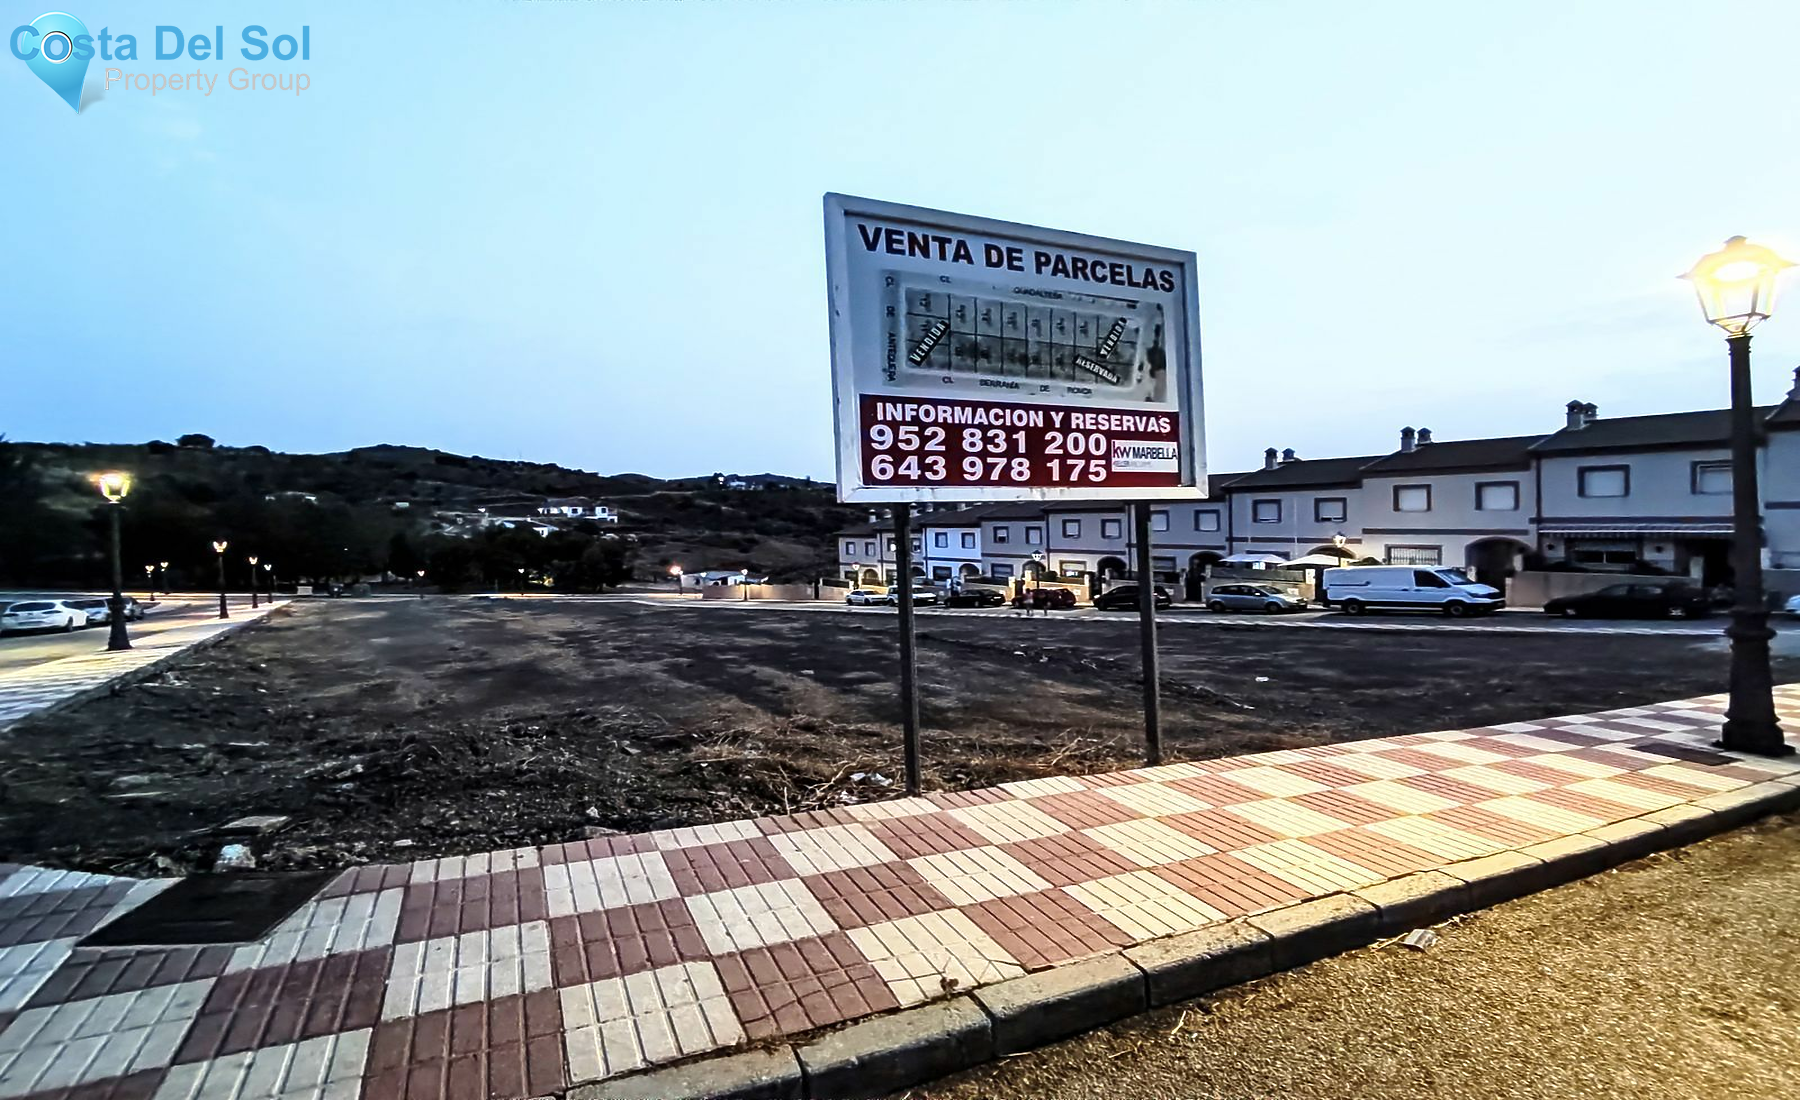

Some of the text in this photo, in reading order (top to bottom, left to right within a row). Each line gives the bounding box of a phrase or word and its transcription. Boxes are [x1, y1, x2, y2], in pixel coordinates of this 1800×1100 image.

[858, 224, 1175, 293] VENTA DE PARCELAS
[909, 322, 947, 363] VENDIDA
[1039, 385, 1051, 393] DE
[876, 402, 1170, 433] INFORMACION Y RESERVAS
[870, 424, 1107, 456] 952 831 200
[1132, 446, 1178, 460] MARBELLA
[871, 454, 1107, 483] 643 978 175
